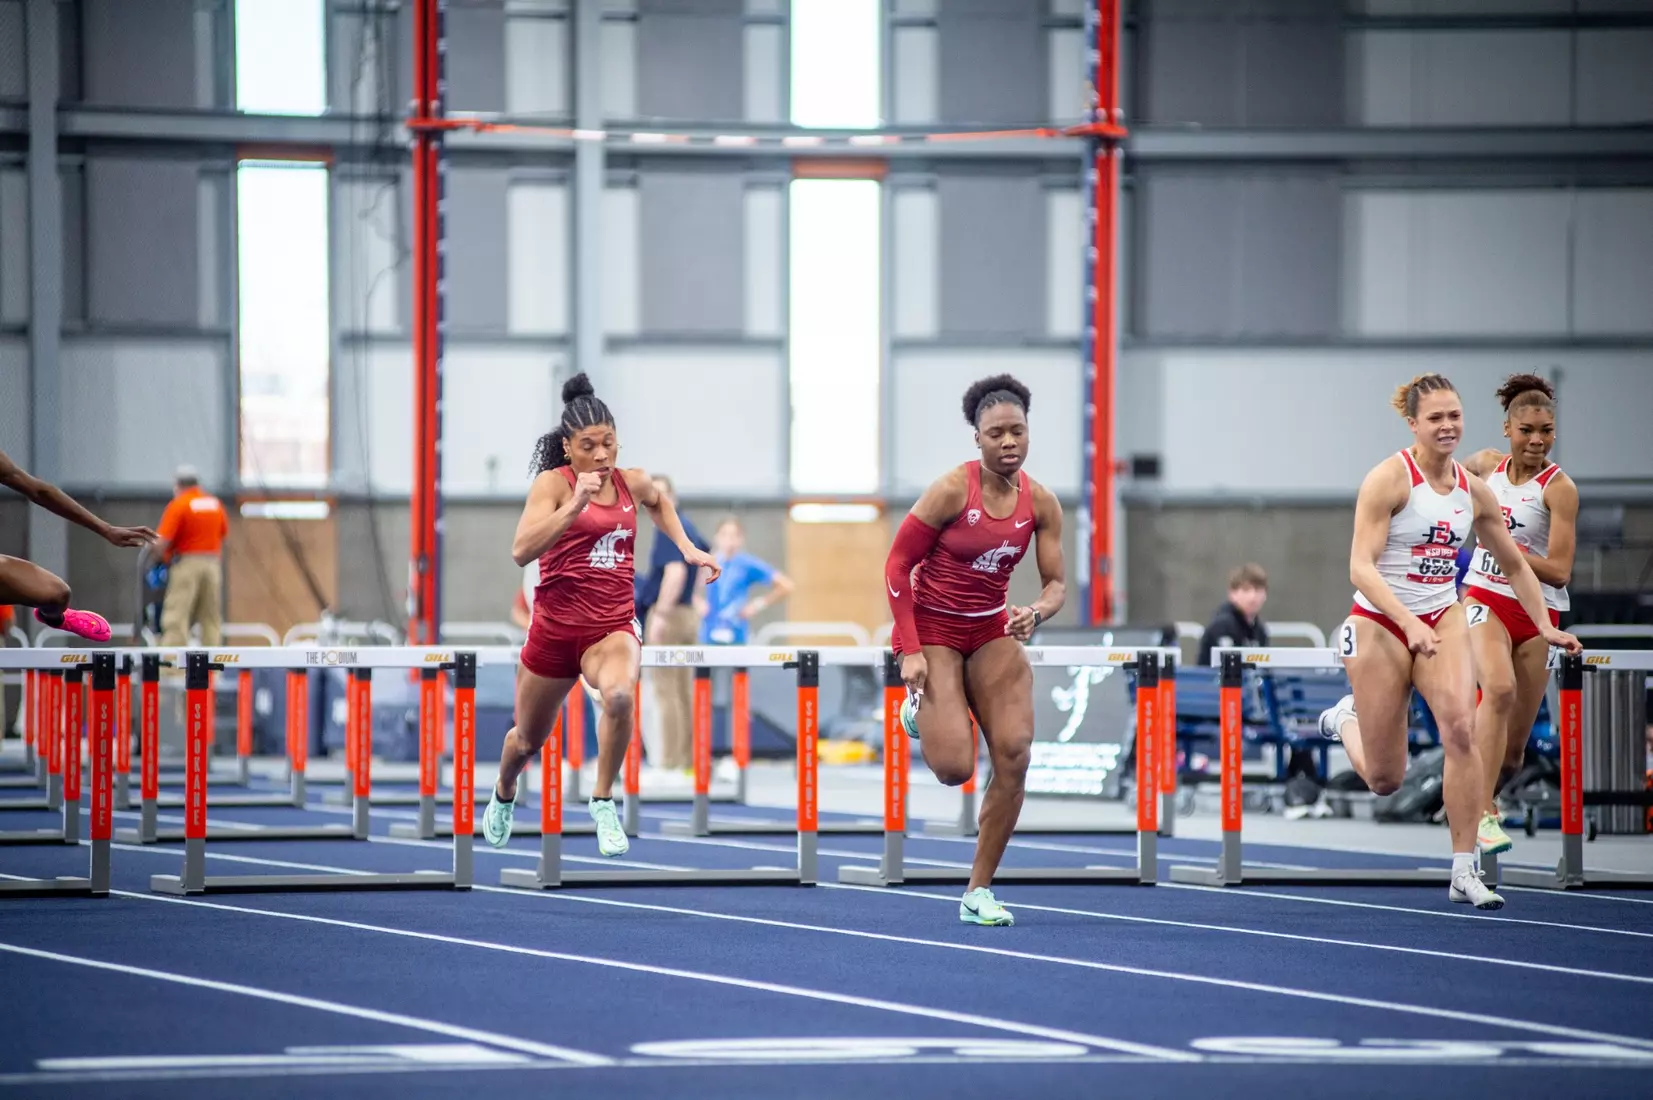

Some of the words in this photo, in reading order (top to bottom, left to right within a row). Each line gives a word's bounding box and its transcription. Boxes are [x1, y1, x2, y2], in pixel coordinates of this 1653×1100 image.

[1470, 605, 1483, 625] 2
[1343, 625, 1353, 655] 3
[60, 654, 88, 663] GILL
[213, 654, 240, 663] GILL
[306, 651, 318, 664] THE
[424, 653, 449, 662] GILL
[655, 651, 667, 663] THE
[769, 653, 793, 661] GILL
[1108, 653, 1132, 661] GILL
[1246, 654, 1271, 662] GILL
[1585, 655, 1611, 664] GILL
[99, 703, 107, 826] SPOKANE
[193, 703, 201, 826] SPOKANE
[461, 702, 469, 823] SPOKANE
[805, 700, 813, 819] SPOKANE
[1569, 703, 1577, 822] SPOKANE
